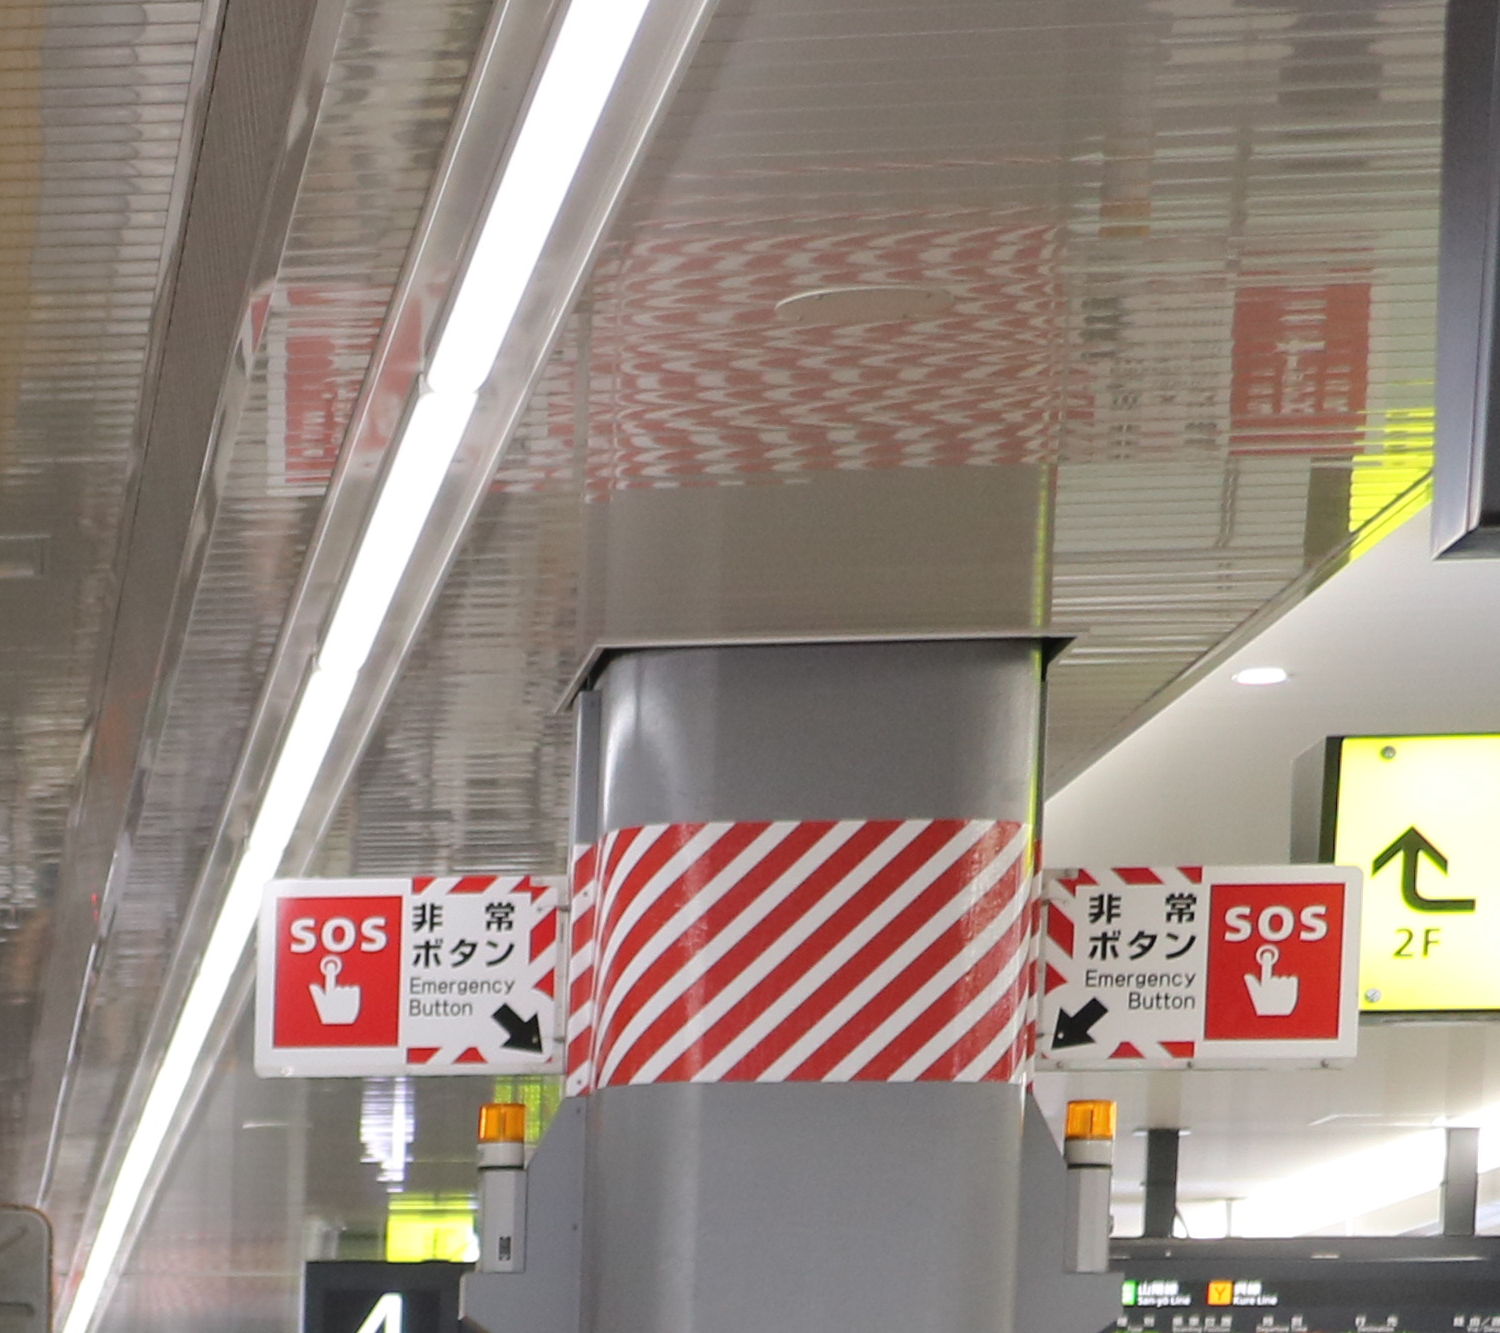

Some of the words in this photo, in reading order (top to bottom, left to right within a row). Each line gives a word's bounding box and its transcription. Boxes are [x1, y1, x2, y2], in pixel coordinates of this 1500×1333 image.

[411, 901, 516, 933] 非常
[1088, 892, 1197, 925] 非常
[1224, 905, 1329, 942] SOS
[289, 916, 388, 954] SOS
[1088, 930, 1197, 961] ボタン
[1393, 927, 1441, 958] 2F
[411, 938, 516, 969] ボタン
[408, 976, 516, 995] Emergency
[1085, 970, 1197, 989] Emergency
[408, 999, 474, 1017] Button
[1128, 992, 1196, 1011] Button
